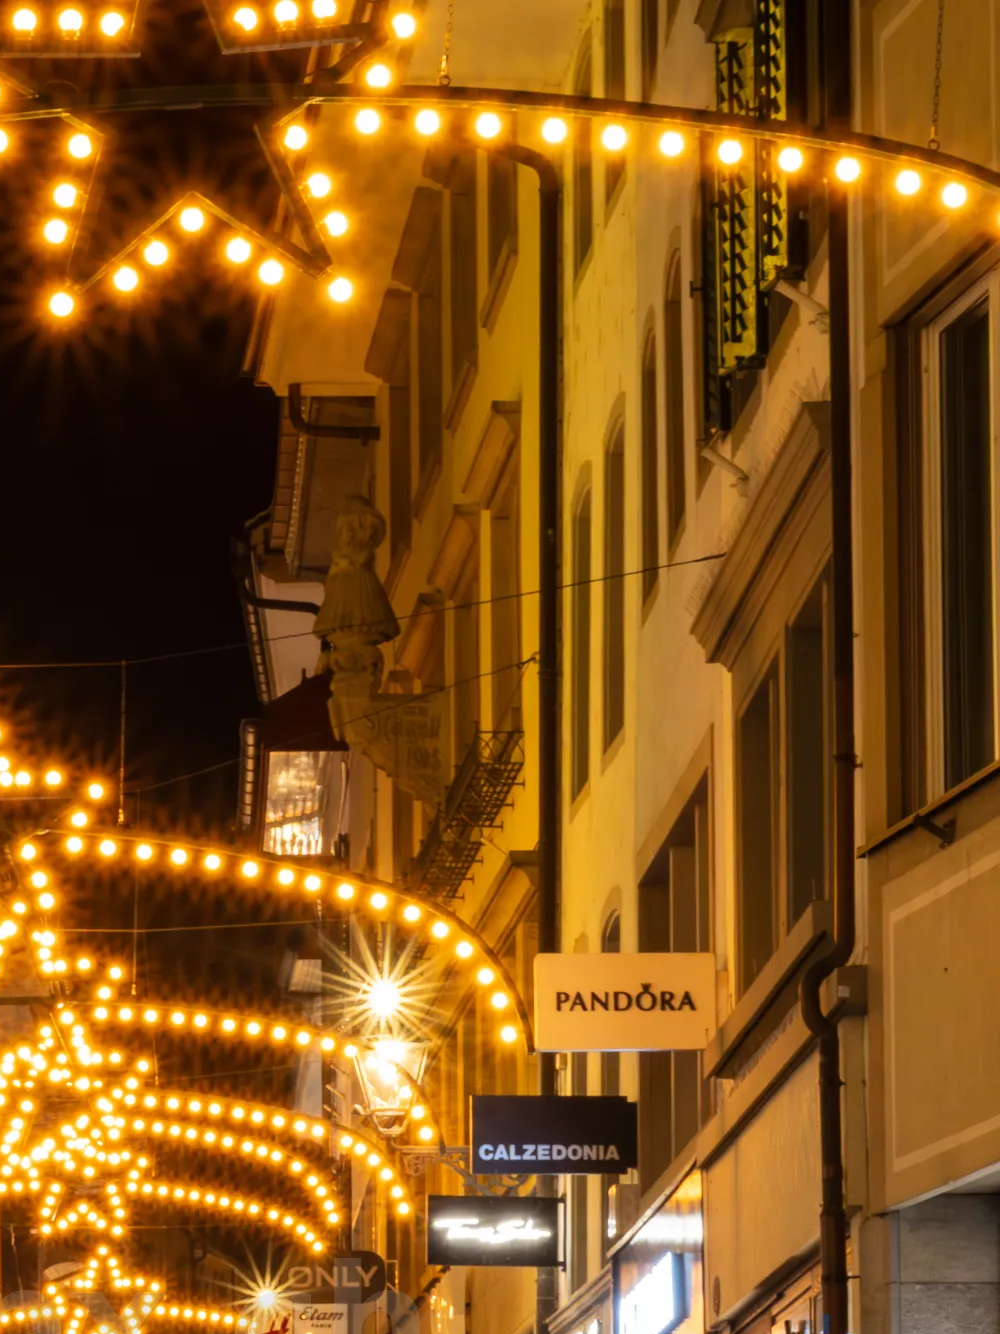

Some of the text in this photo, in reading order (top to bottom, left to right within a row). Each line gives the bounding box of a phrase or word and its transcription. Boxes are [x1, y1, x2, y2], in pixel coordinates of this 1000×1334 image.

[555, 988, 698, 1012] PANDORA
[478, 1143, 621, 1162] CALZEDONIA
[287, 1265, 379, 1288] ONLY
[299, 1305, 344, 1321] Etam
